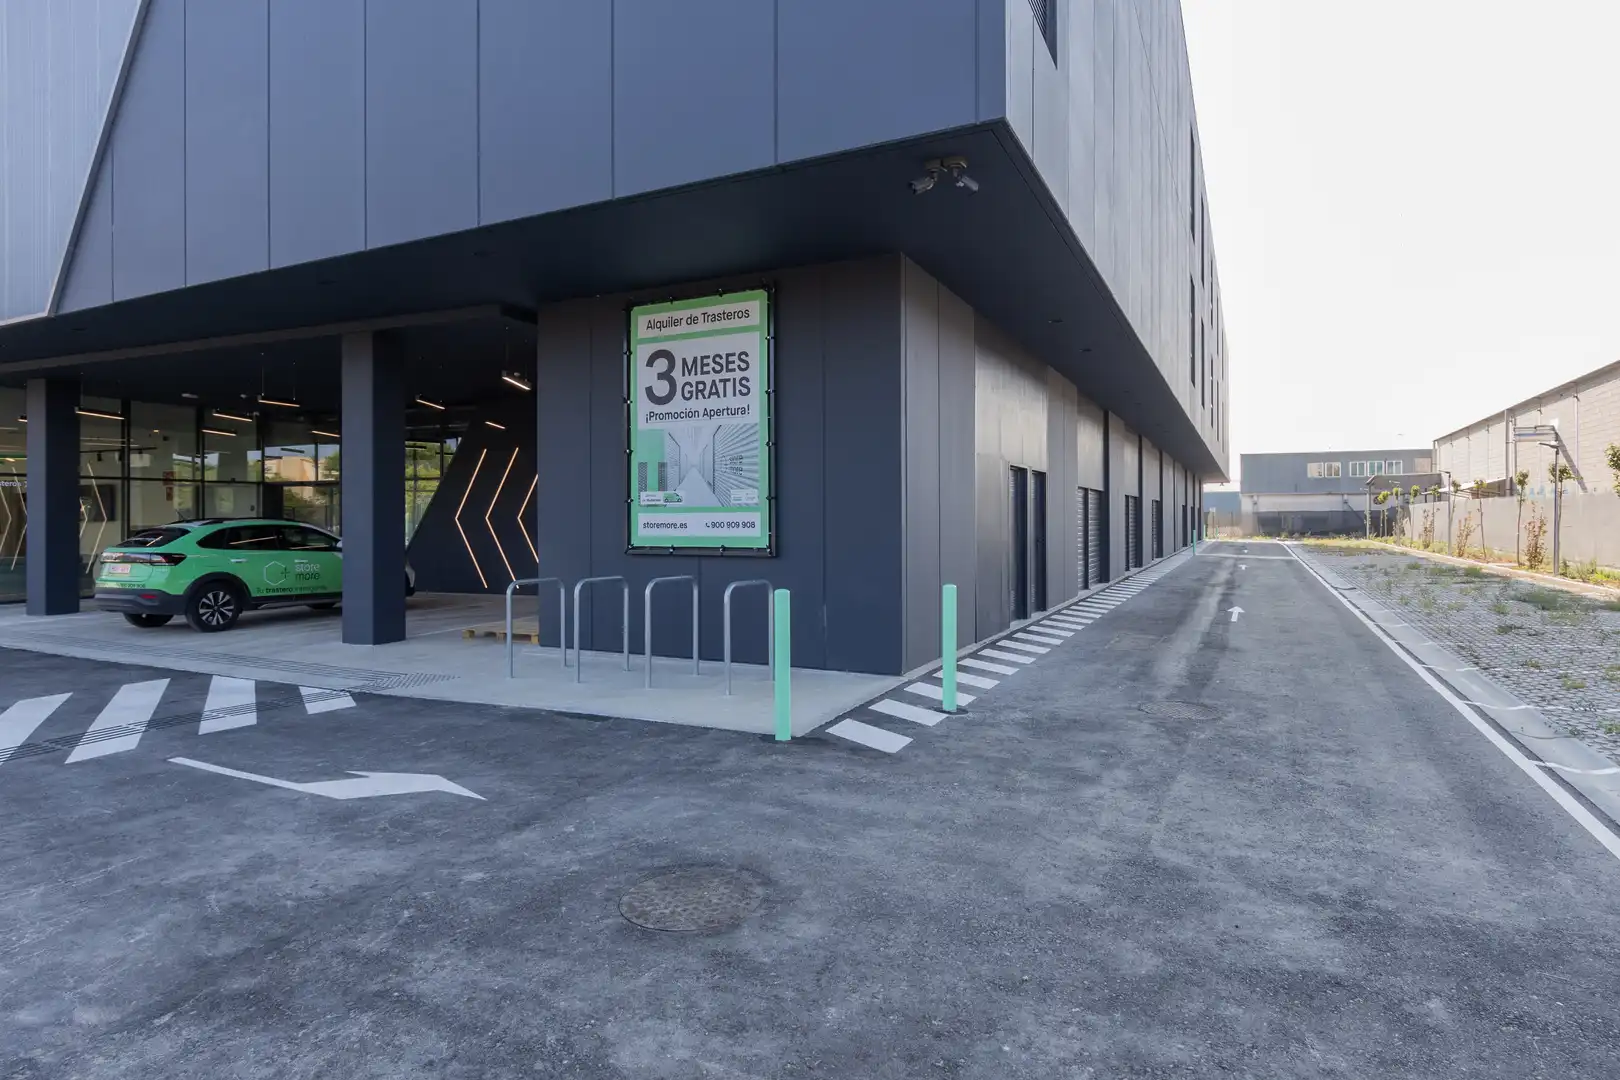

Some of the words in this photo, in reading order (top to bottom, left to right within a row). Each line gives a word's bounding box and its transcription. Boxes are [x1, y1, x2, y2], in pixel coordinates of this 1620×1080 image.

[646, 316, 683, 332] Alquiler
[686, 313, 699, 325] de
[701, 309, 750, 324] Trasteros
[645, 349, 678, 406] 3
[681, 350, 750, 377] MESES
[681, 376, 751, 401] GRATIS
[645, 407, 700, 423] ¡Promoción
[702, 404, 750, 420] Apertura!
[643, 521, 688, 529] storemore.es
[711, 521, 725, 529] 900
[726, 521, 740, 529] 909
[741, 521, 756, 529] 908
[295, 563, 320, 572] store
[295, 572, 320, 581] more
